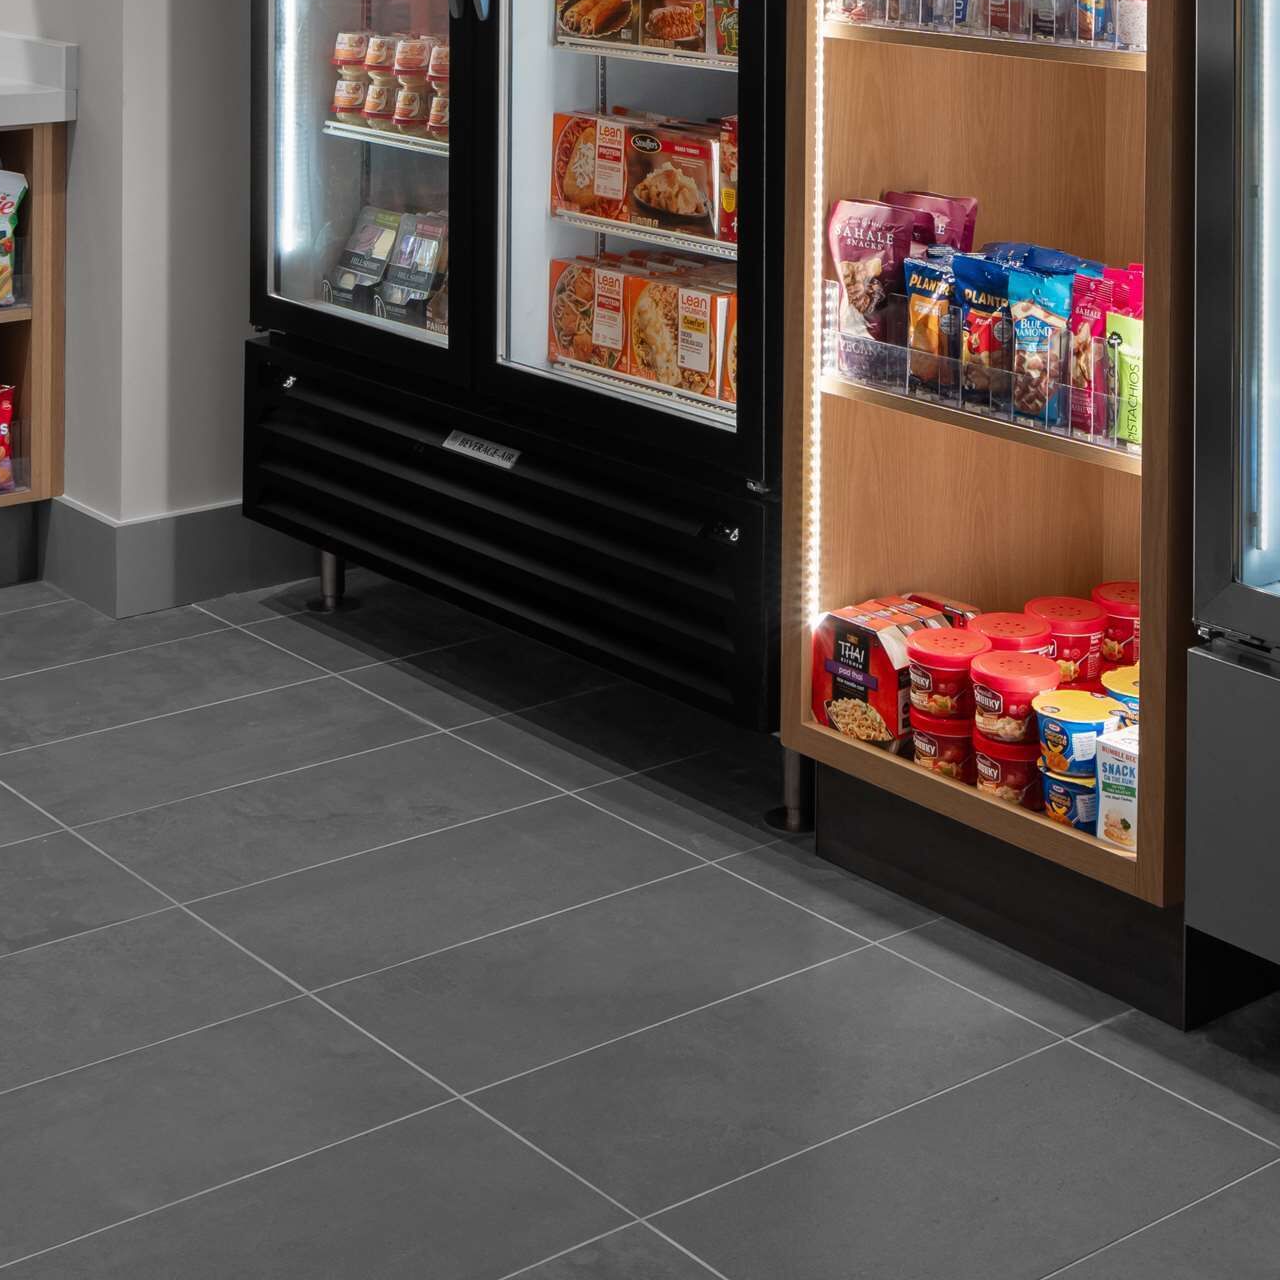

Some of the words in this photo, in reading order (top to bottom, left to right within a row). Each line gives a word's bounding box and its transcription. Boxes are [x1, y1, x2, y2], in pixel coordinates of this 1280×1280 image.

[599, 125, 622, 138] Lean
[834, 224, 895, 246] SAHALE
[846, 238, 883, 251] SNACKS
[681, 293, 707, 309] Lean
[1020, 318, 1043, 330] BLUE
[838, 640, 865, 665] THAI
[1102, 761, 1137, 779] SNACK
